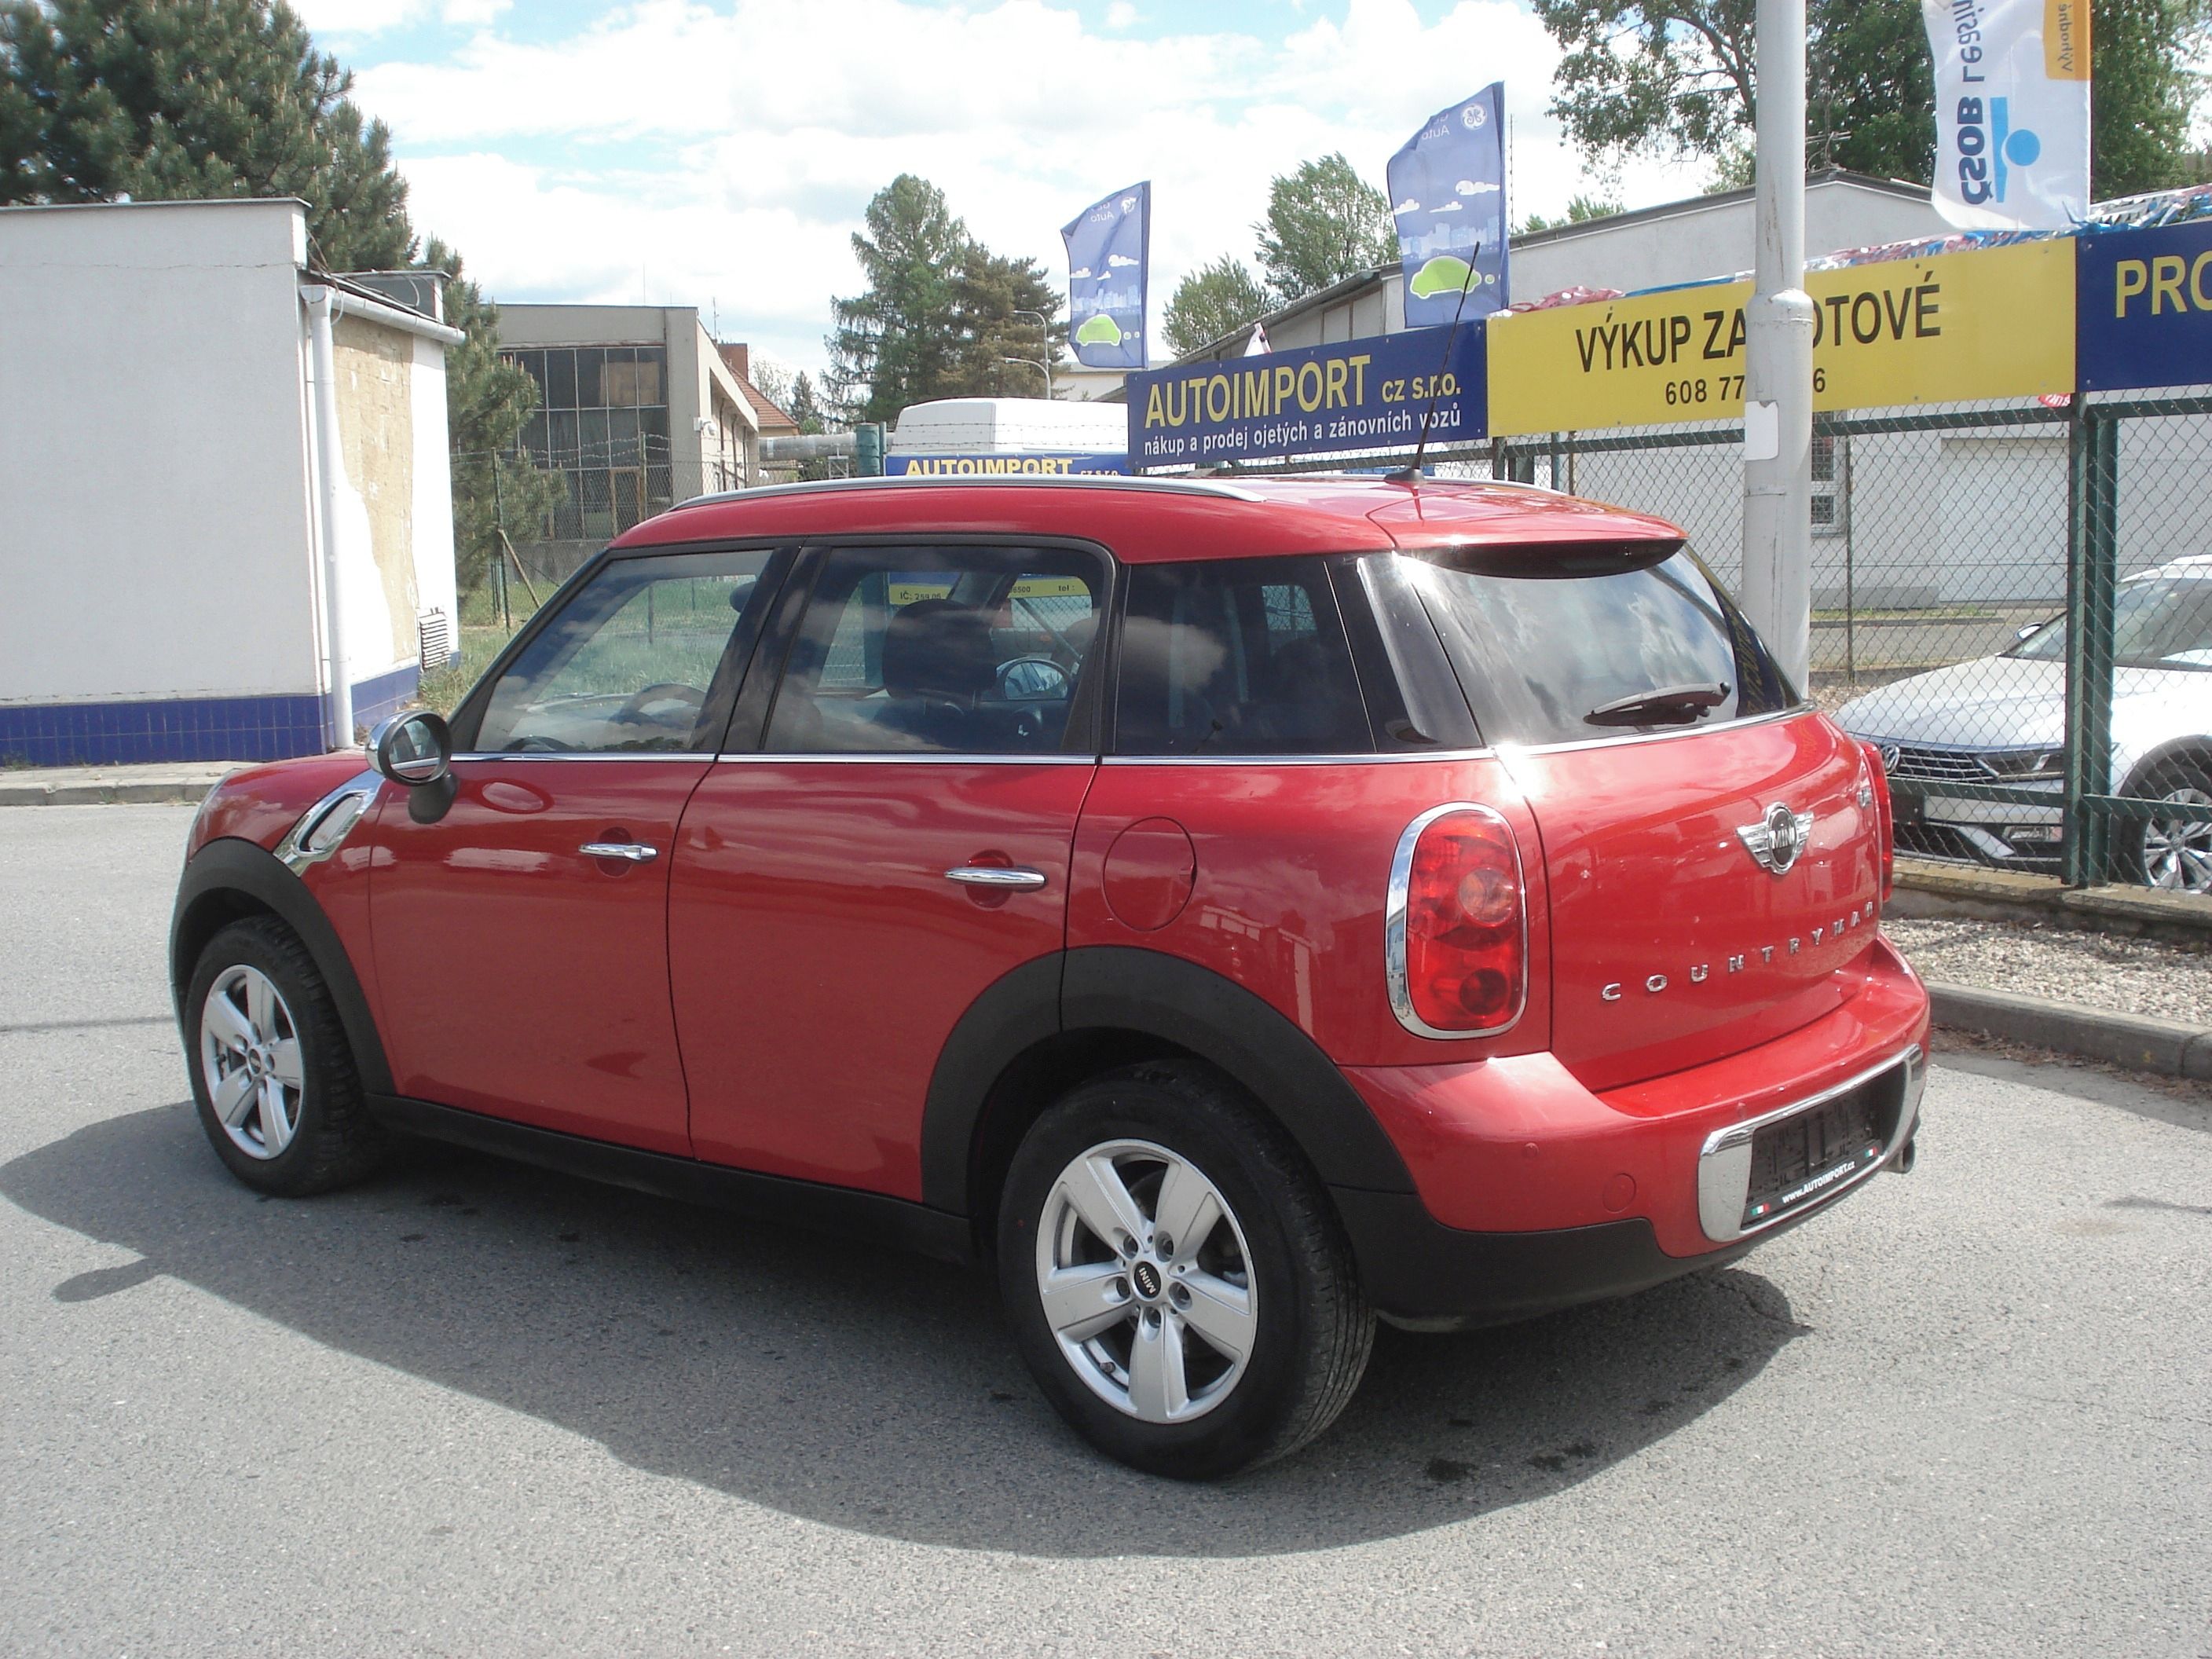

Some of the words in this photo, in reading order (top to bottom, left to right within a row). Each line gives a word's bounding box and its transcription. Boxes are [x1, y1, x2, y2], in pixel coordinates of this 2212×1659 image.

[1575, 312, 1691, 373] VÝKUP
[1144, 354, 1371, 429] AUTOIMPORT
[1382, 379, 1405, 404] cz
[1412, 372, 1462, 400] s.r.o.
[1664, 379, 1708, 405] 608
[1144, 432, 1185, 457] nákup
[1190, 437, 1199, 452] a
[1203, 427, 1248, 454] prodej
[1254, 420, 1308, 448] ojetých
[1314, 425, 1323, 440] a
[1329, 408, 1412, 438] zánovních
[1419, 401, 1461, 430] vozů
[905, 458, 1074, 476] AUTOIMPORT
[1601, 900, 1873, 1001] COUNTRYMAN
[1138, 1266, 1157, 1295] MINI
